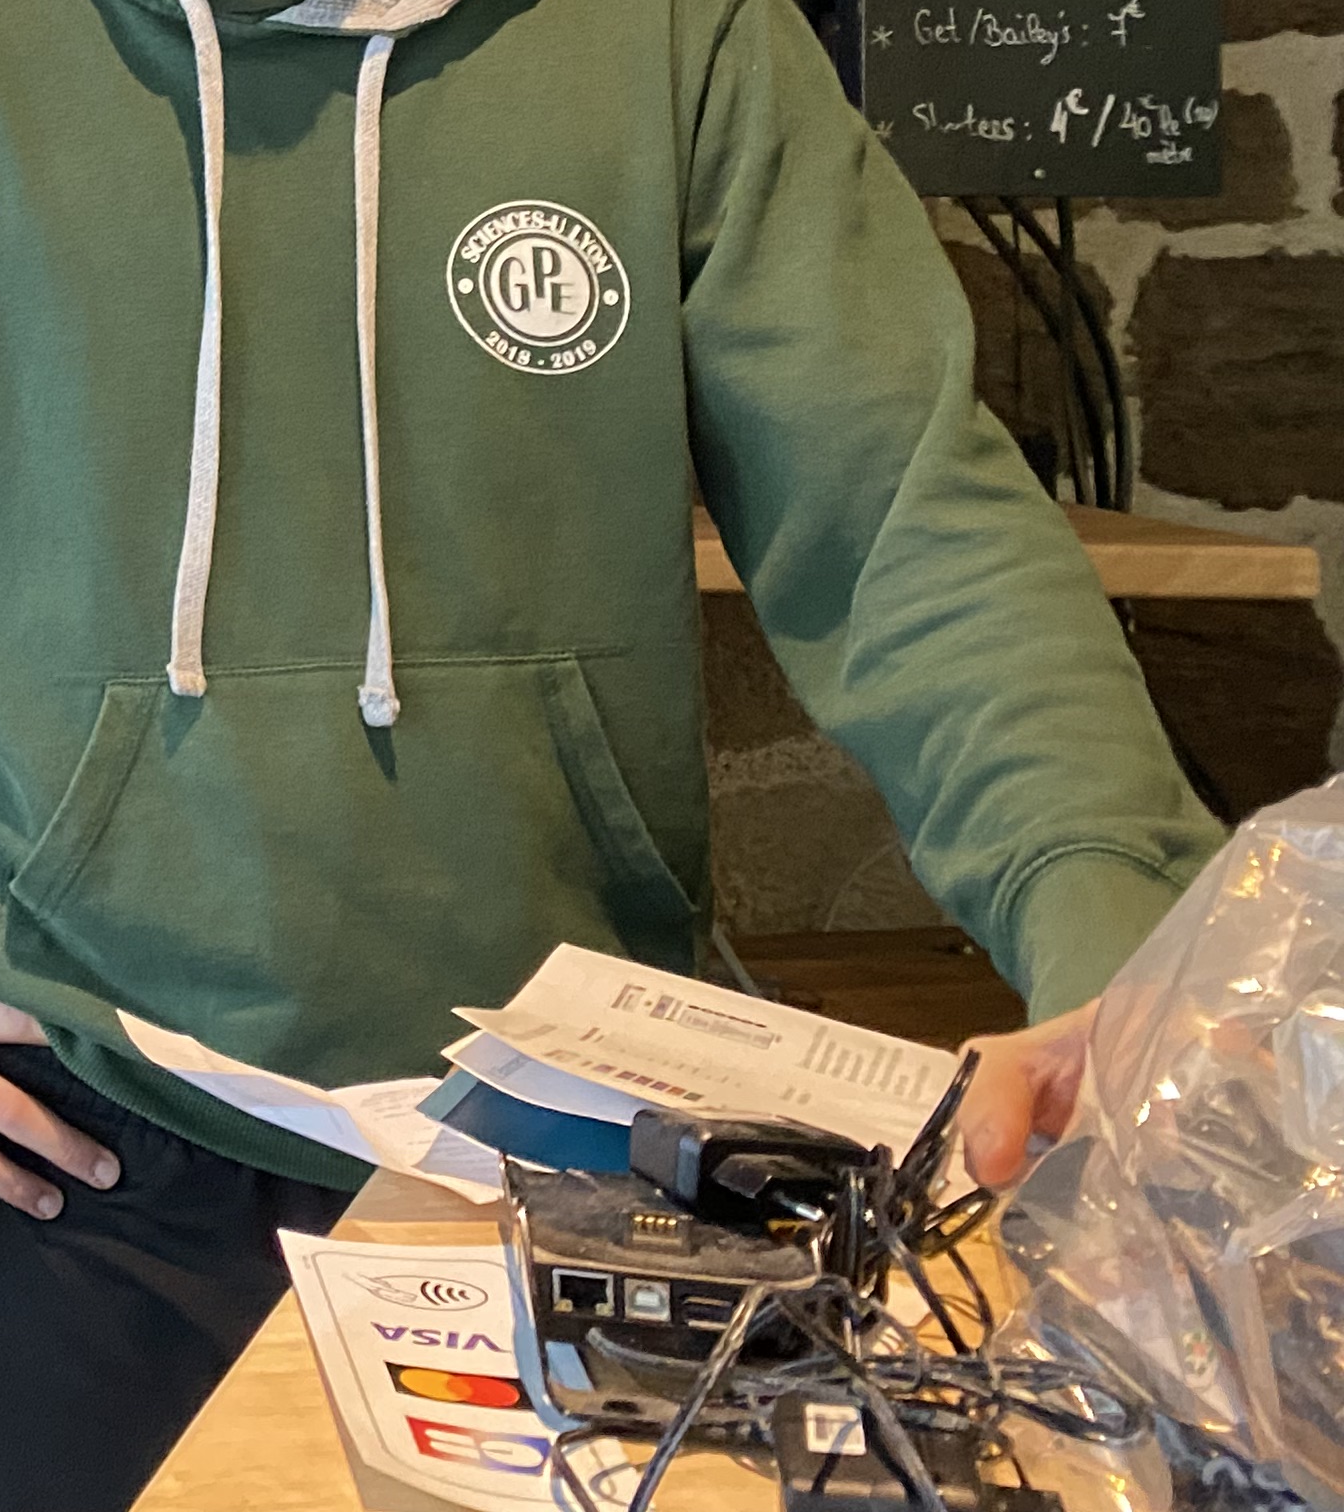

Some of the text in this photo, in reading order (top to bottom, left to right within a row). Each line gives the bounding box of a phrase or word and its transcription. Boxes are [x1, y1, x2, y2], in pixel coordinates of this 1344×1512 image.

[566, 223, 613, 276] LYON
[550, 339, 598, 369] 2019
[370, 1321, 512, 1354] VISA
